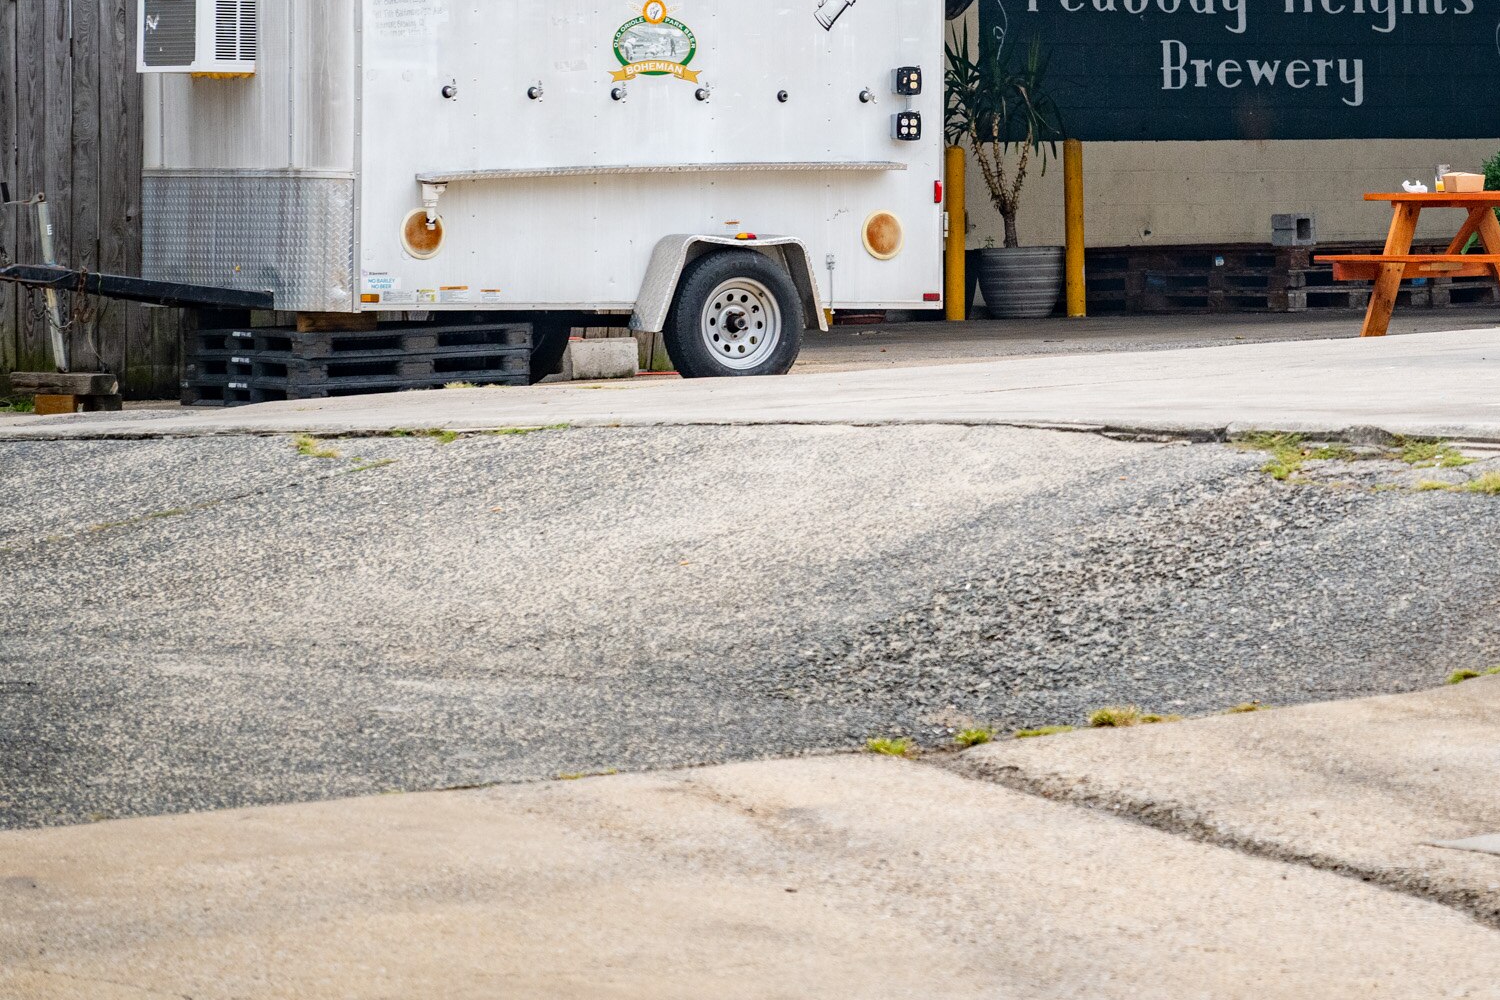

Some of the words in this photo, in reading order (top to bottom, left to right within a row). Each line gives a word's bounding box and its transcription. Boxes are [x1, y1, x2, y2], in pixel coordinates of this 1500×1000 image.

[620, 17, 644, 32] ORIOLE
[665, 18, 682, 29] PARK
[684, 29, 695, 48] BEER
[626, 62, 682, 74] BOHEMIAN
[1160, 40, 1363, 106] Brewery
